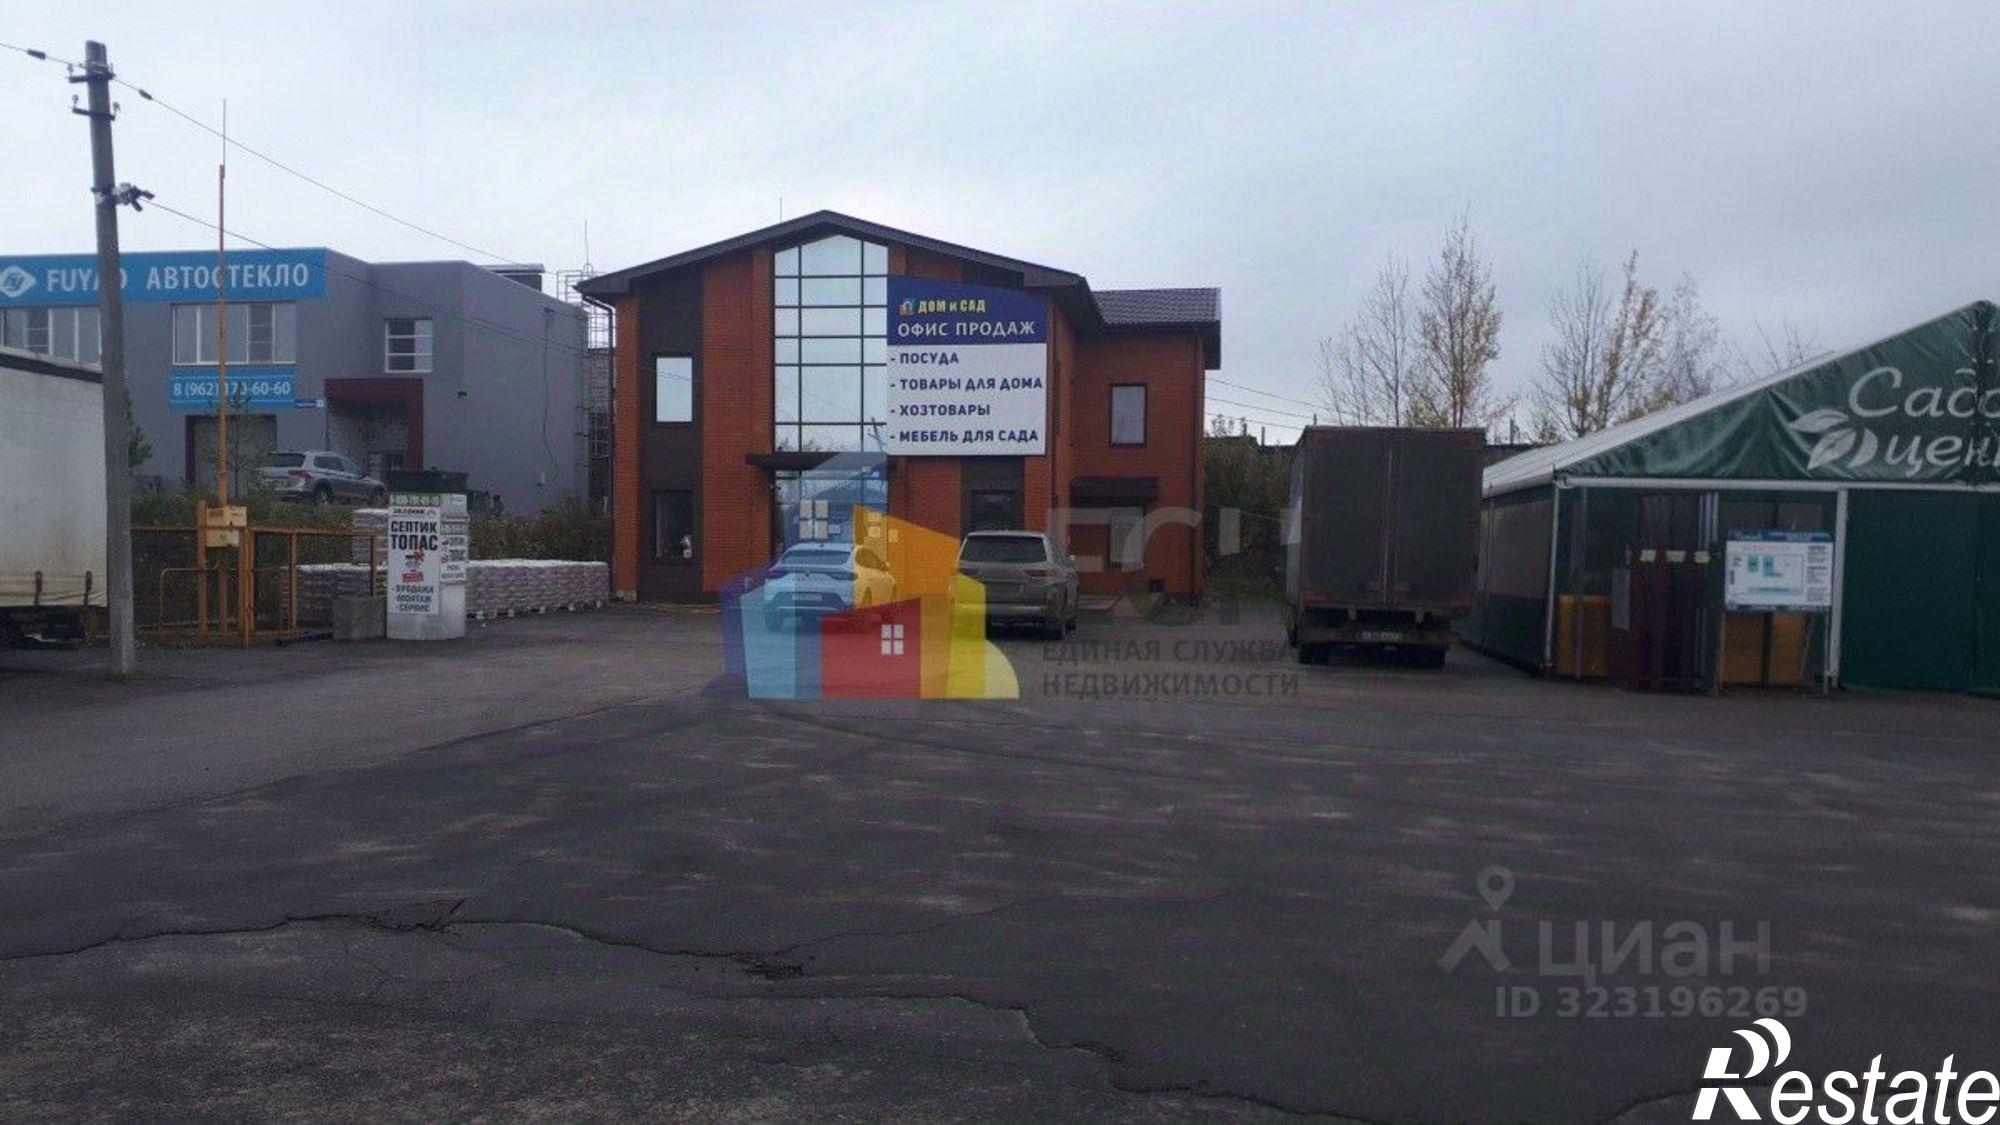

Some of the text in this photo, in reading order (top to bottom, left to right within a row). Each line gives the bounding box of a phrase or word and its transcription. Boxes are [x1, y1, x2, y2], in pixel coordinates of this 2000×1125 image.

[146, 263, 309, 290] АВТОСТЕКЛО
[918, 300, 946, 313] ДОМ
[960, 299, 986, 313] САД
[898, 321, 1035, 337] ОФИС ПРОДАЖ
[899, 352, 959, 366] ПОСУДА
[174, 382, 181, 396] 8
[185, 382, 219, 398] (962)
[899, 379, 961, 391] ТОВАРЫ
[965, 378, 995, 391] ДЛЯ
[999, 378, 1043, 391] ДОМА
[899, 404, 991, 416] ХОЗТОВАРЫ
[899, 430, 958, 443] МЕБЕЛЬ
[962, 430, 994, 443] ДЛЯ
[998, 429, 1039, 443] САДА
[391, 521, 438, 533] СЕПТИК
[390, 534, 438, 551] ТОПАС
